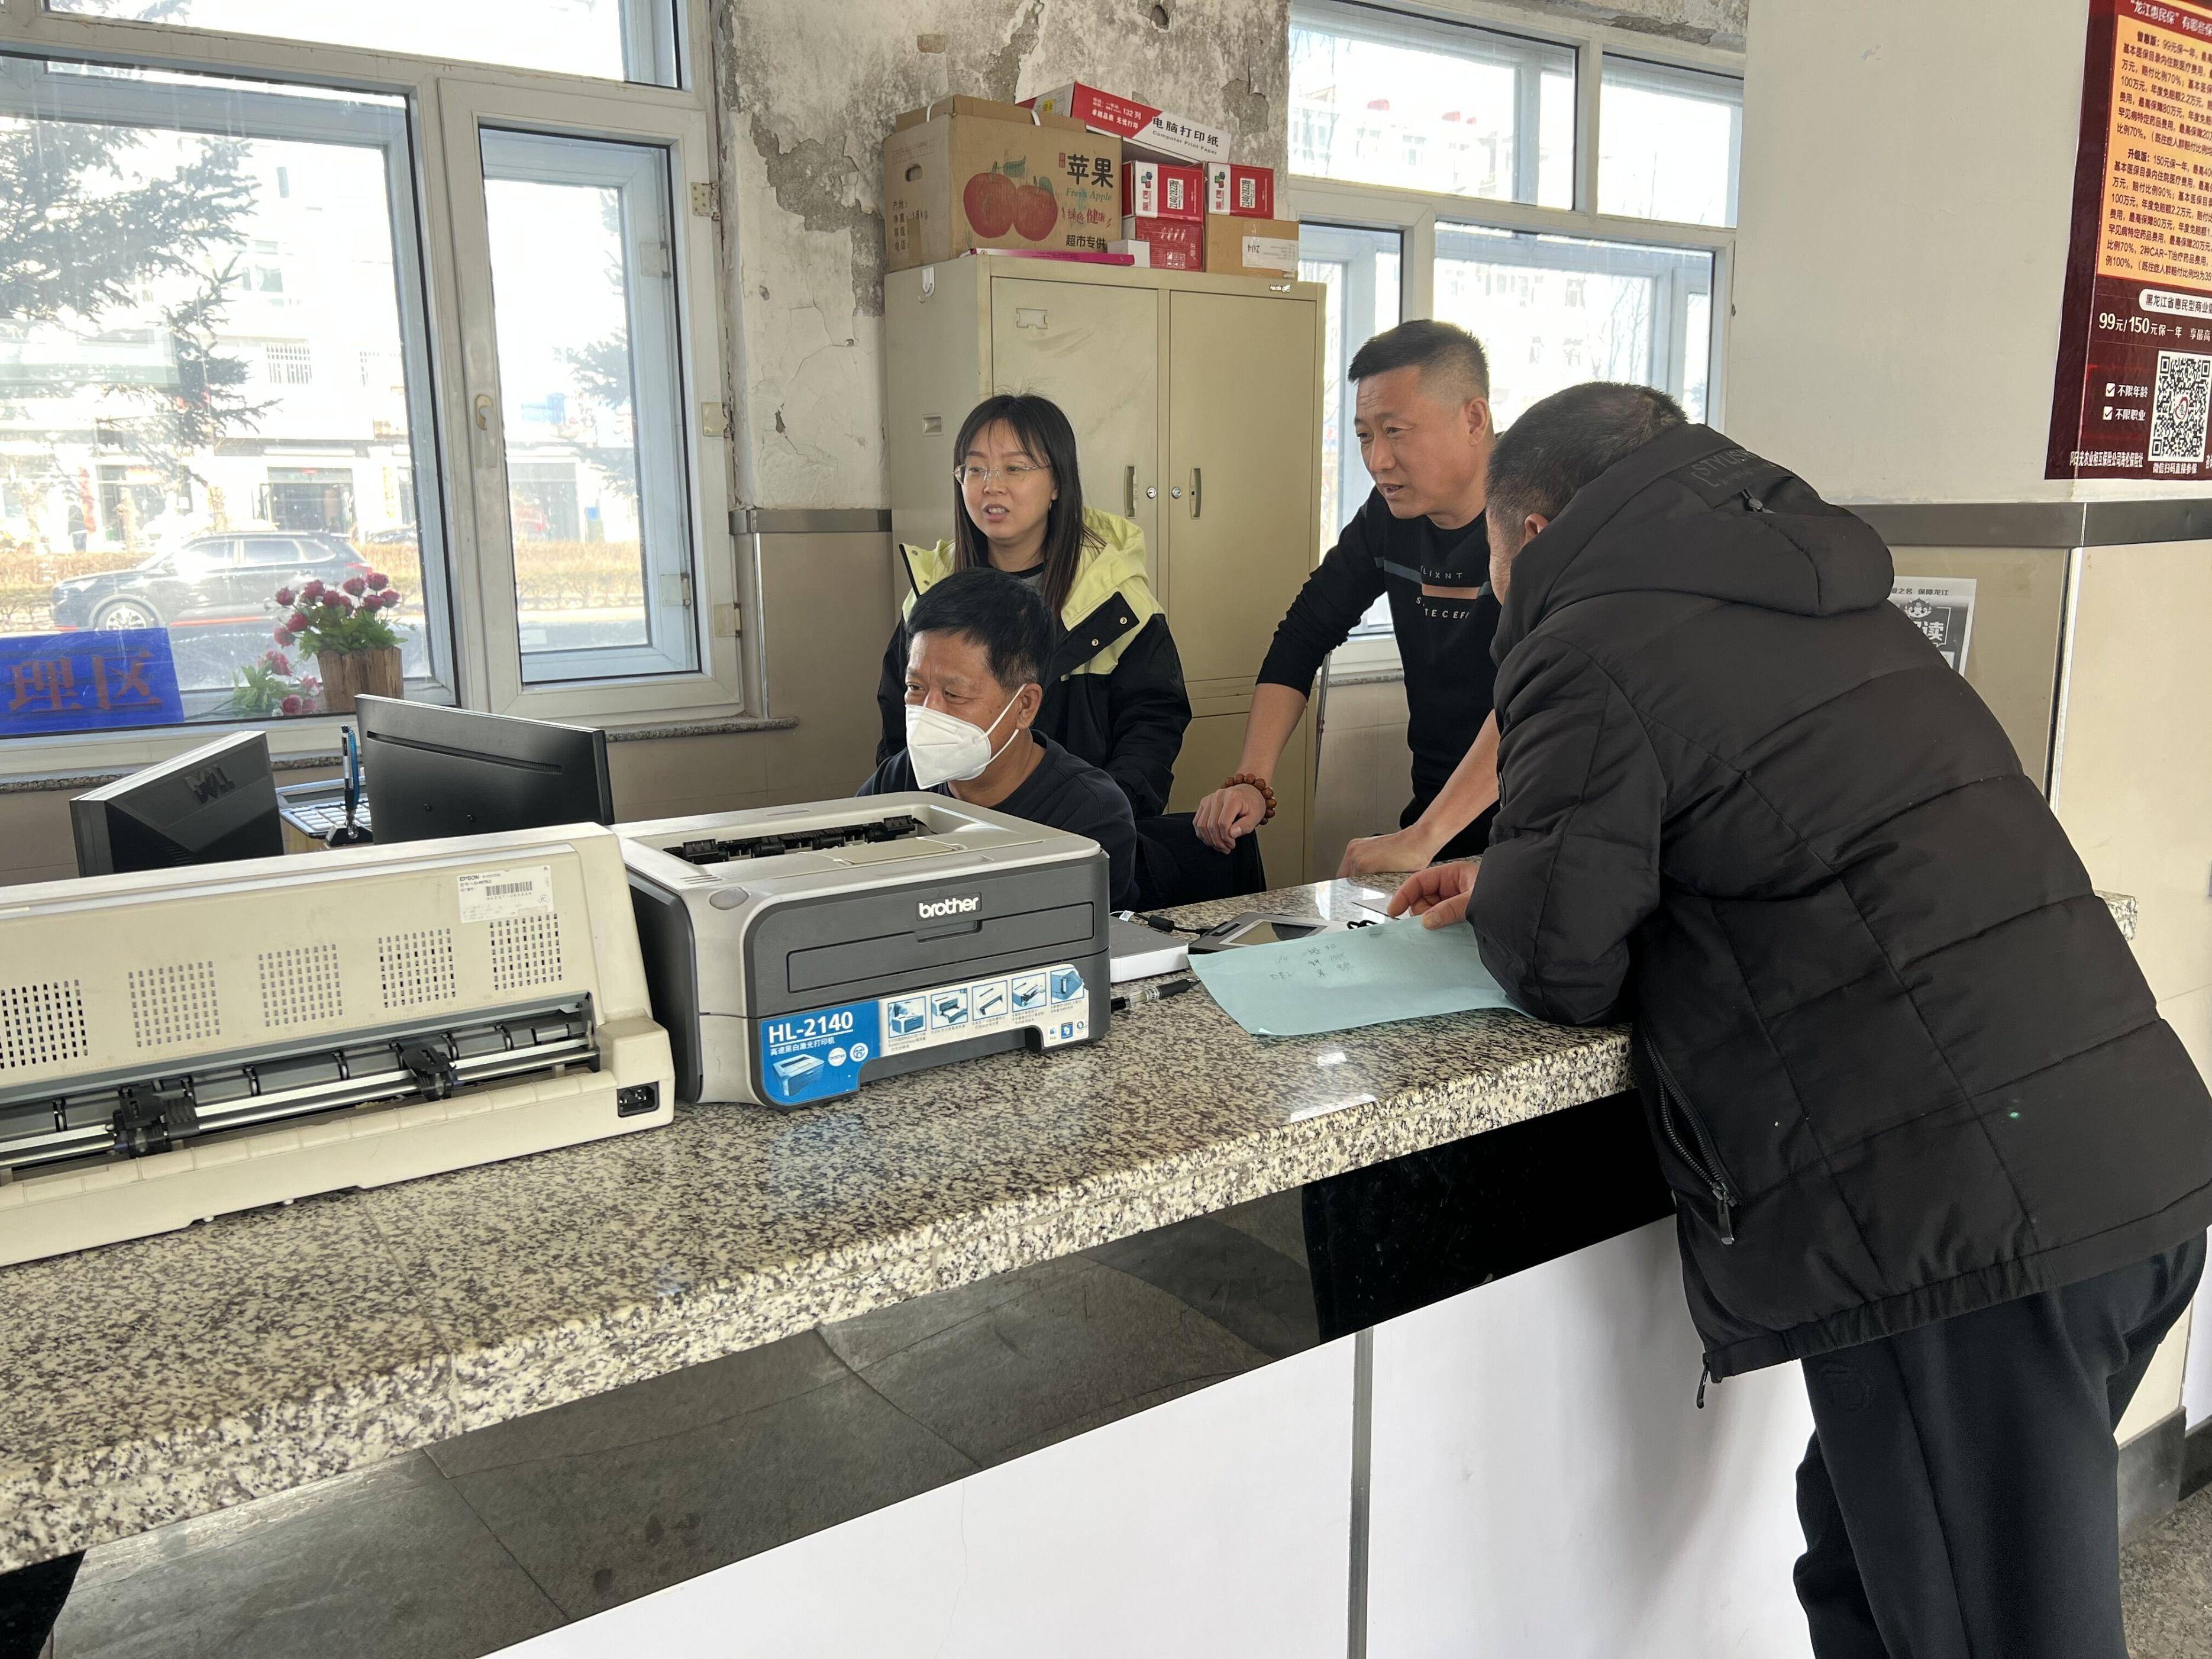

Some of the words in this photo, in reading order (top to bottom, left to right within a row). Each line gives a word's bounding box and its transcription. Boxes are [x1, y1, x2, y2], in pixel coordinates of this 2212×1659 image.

[1152, 117, 1219, 147] 电脑打印纸
[1152, 130, 1182, 144] Computer
[1184, 140, 1199, 150] Print
[1200, 146, 1218, 155] Paper
[1067, 154, 1113, 188] 苹果
[2128, 149, 2212, 177] 升级版：150元保一年，最高40
[1065, 188, 1087, 198] Fresh
[1089, 191, 1112, 202] Apple
[1068, 208, 1084, 225] 绿色
[1066, 234, 1106, 250] 超市专供
[2107, 240, 2212, 266] 比例70%，2种CAR-T治疗药品费用，
[2106, 256, 2212, 282] 例100%。（既往症人群赔付比例均为35
[2190, 328, 2212, 343] 享最高
[2117, 385, 2148, 398] 不限年龄
[2115, 408, 2146, 421] 不限职业
[2152, 462, 2198, 475] 微信扫码直接参保
[5, 650, 163, 713] 理区
[919, 897, 979, 918] brother
[768, 1011, 854, 1044] HL-2140
[770, 1037, 835, 1056] 高速黑白激光打印机
